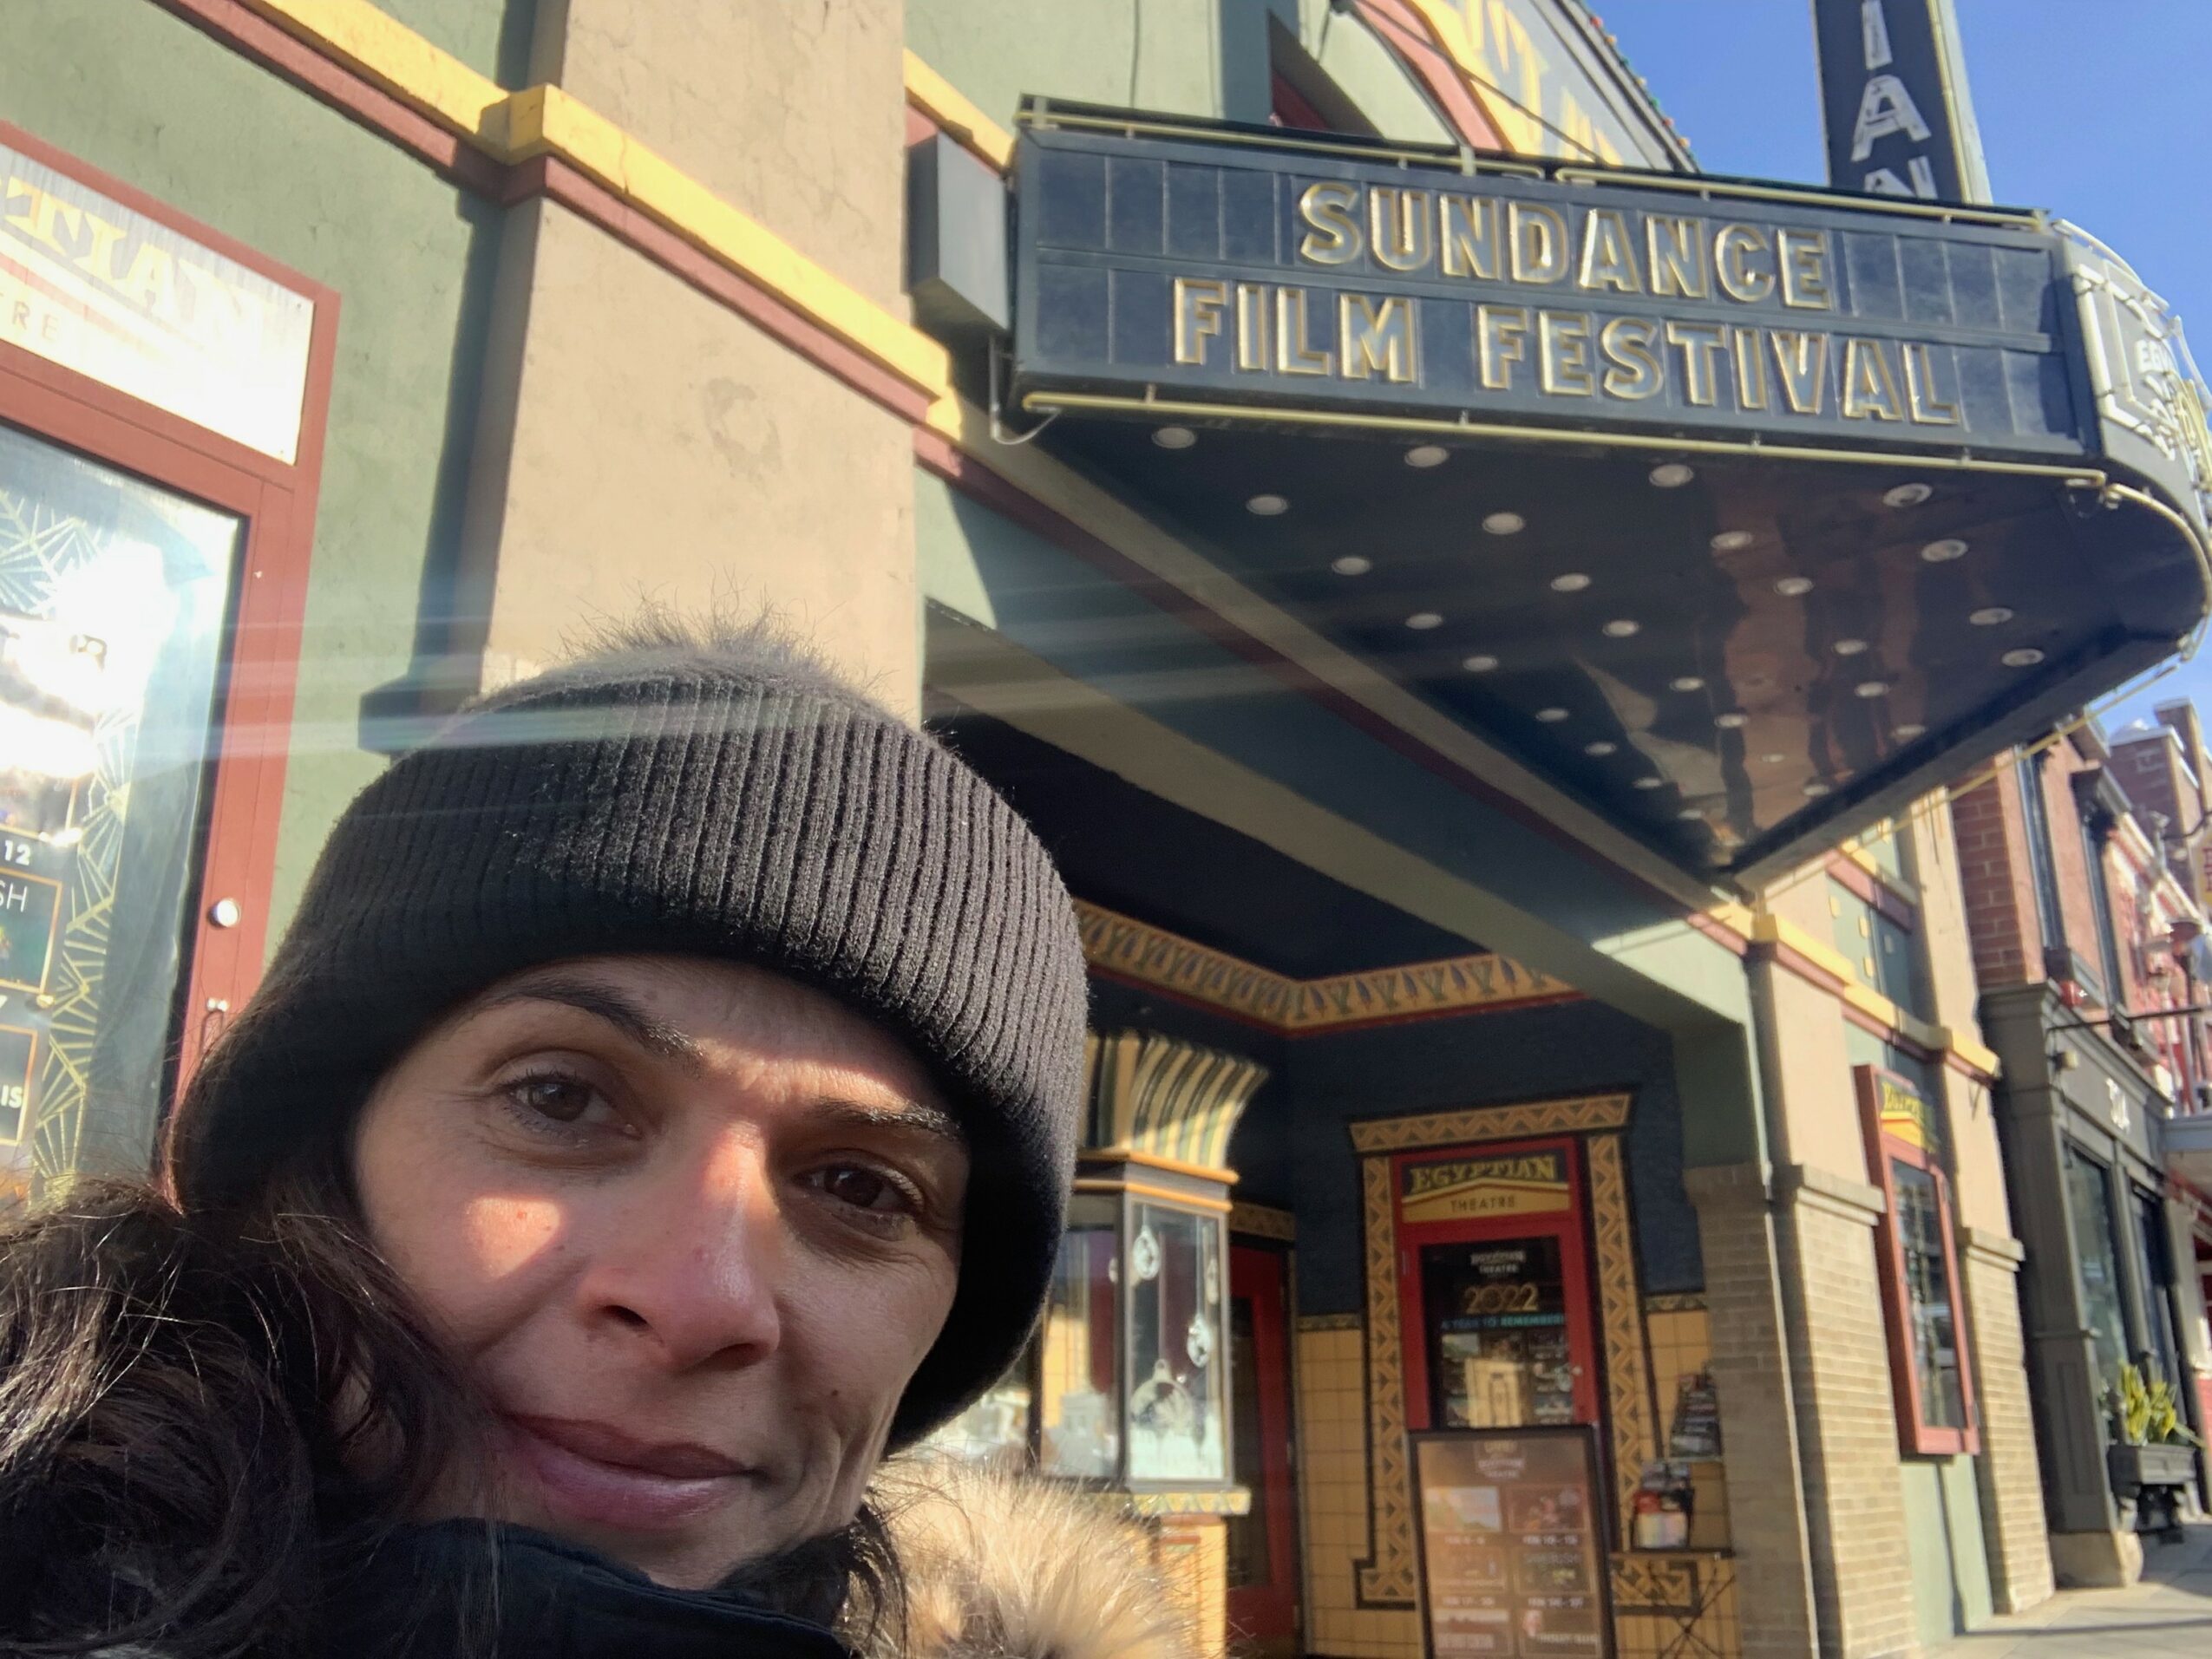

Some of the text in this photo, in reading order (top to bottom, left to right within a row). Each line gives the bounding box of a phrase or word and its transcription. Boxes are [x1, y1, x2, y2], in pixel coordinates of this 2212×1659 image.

[1299, 181, 1833, 310] SUNDANCE
[1174, 276, 1960, 425] FILM FESTIVAL
[4, 839, 30, 865] 12
[1410, 1154, 1556, 1194] EGYPTIAN
[1450, 1195, 1515, 1212] THEATRE
[1464, 1282, 1540, 1315] 2022
